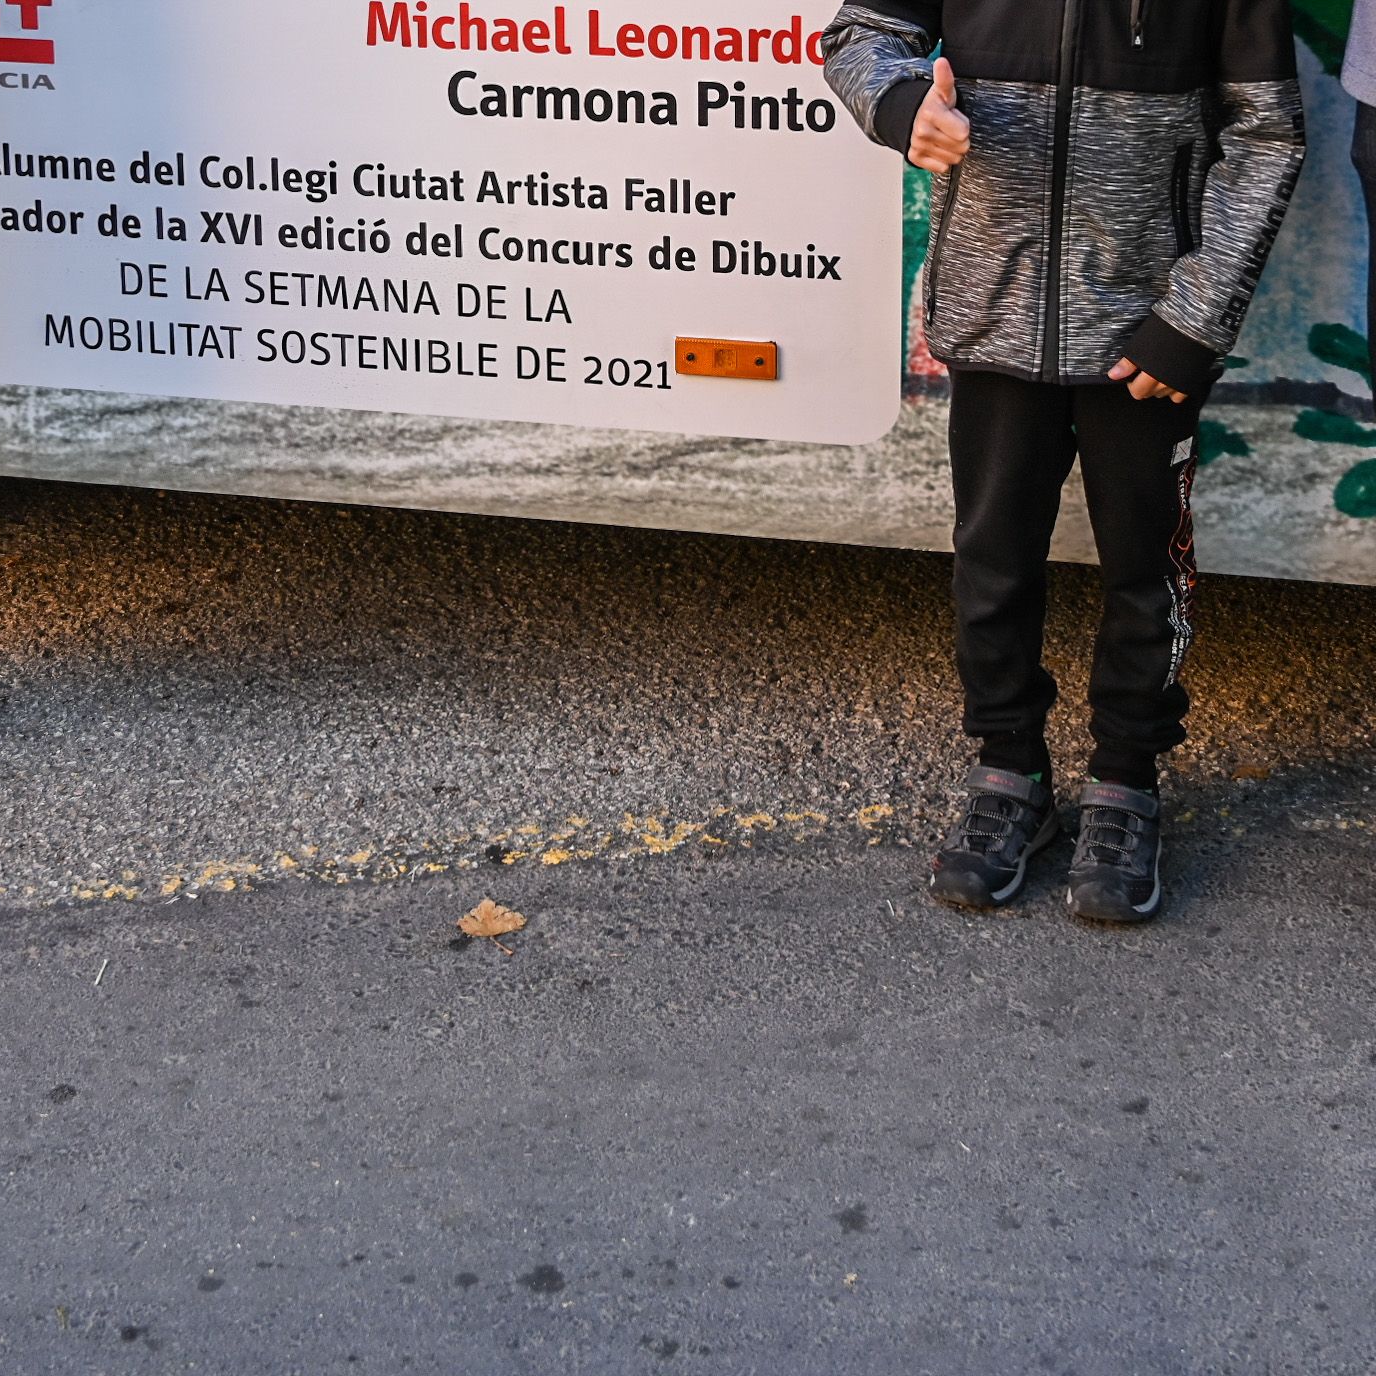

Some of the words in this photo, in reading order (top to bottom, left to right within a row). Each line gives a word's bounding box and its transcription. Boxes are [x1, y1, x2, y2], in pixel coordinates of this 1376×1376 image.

[367, 1, 572, 55] Michael
[448, 71, 677, 125] Carmona
[698, 81, 835, 132] Pinto
[130, 151, 184, 185] del
[200, 156, 337, 202] Col.legi
[354, 163, 464, 201] Ciutat
[477, 171, 607, 209] Artista
[626, 179, 735, 215] Faller
[98, 204, 140, 238] de
[156, 207, 186, 241] la
[201, 212, 262, 245] XVI
[279, 216, 390, 253] edició
[406, 223, 462, 257] del
[479, 228, 632, 267] Concurs
[649, 236, 695, 271] de
[713, 240, 841, 280] Dibuix
[121, 263, 167, 297] DE
[186, 267, 229, 301] LA
[245, 271, 440, 315] SETMANA
[458, 284, 506, 319] DE
[526, 288, 572, 323] LA
[44, 314, 242, 359] MOBILITAT
[258, 329, 497, 377] SOSTENIBLE
[517, 346, 566, 382] DE
[584, 357, 673, 390] 2021
